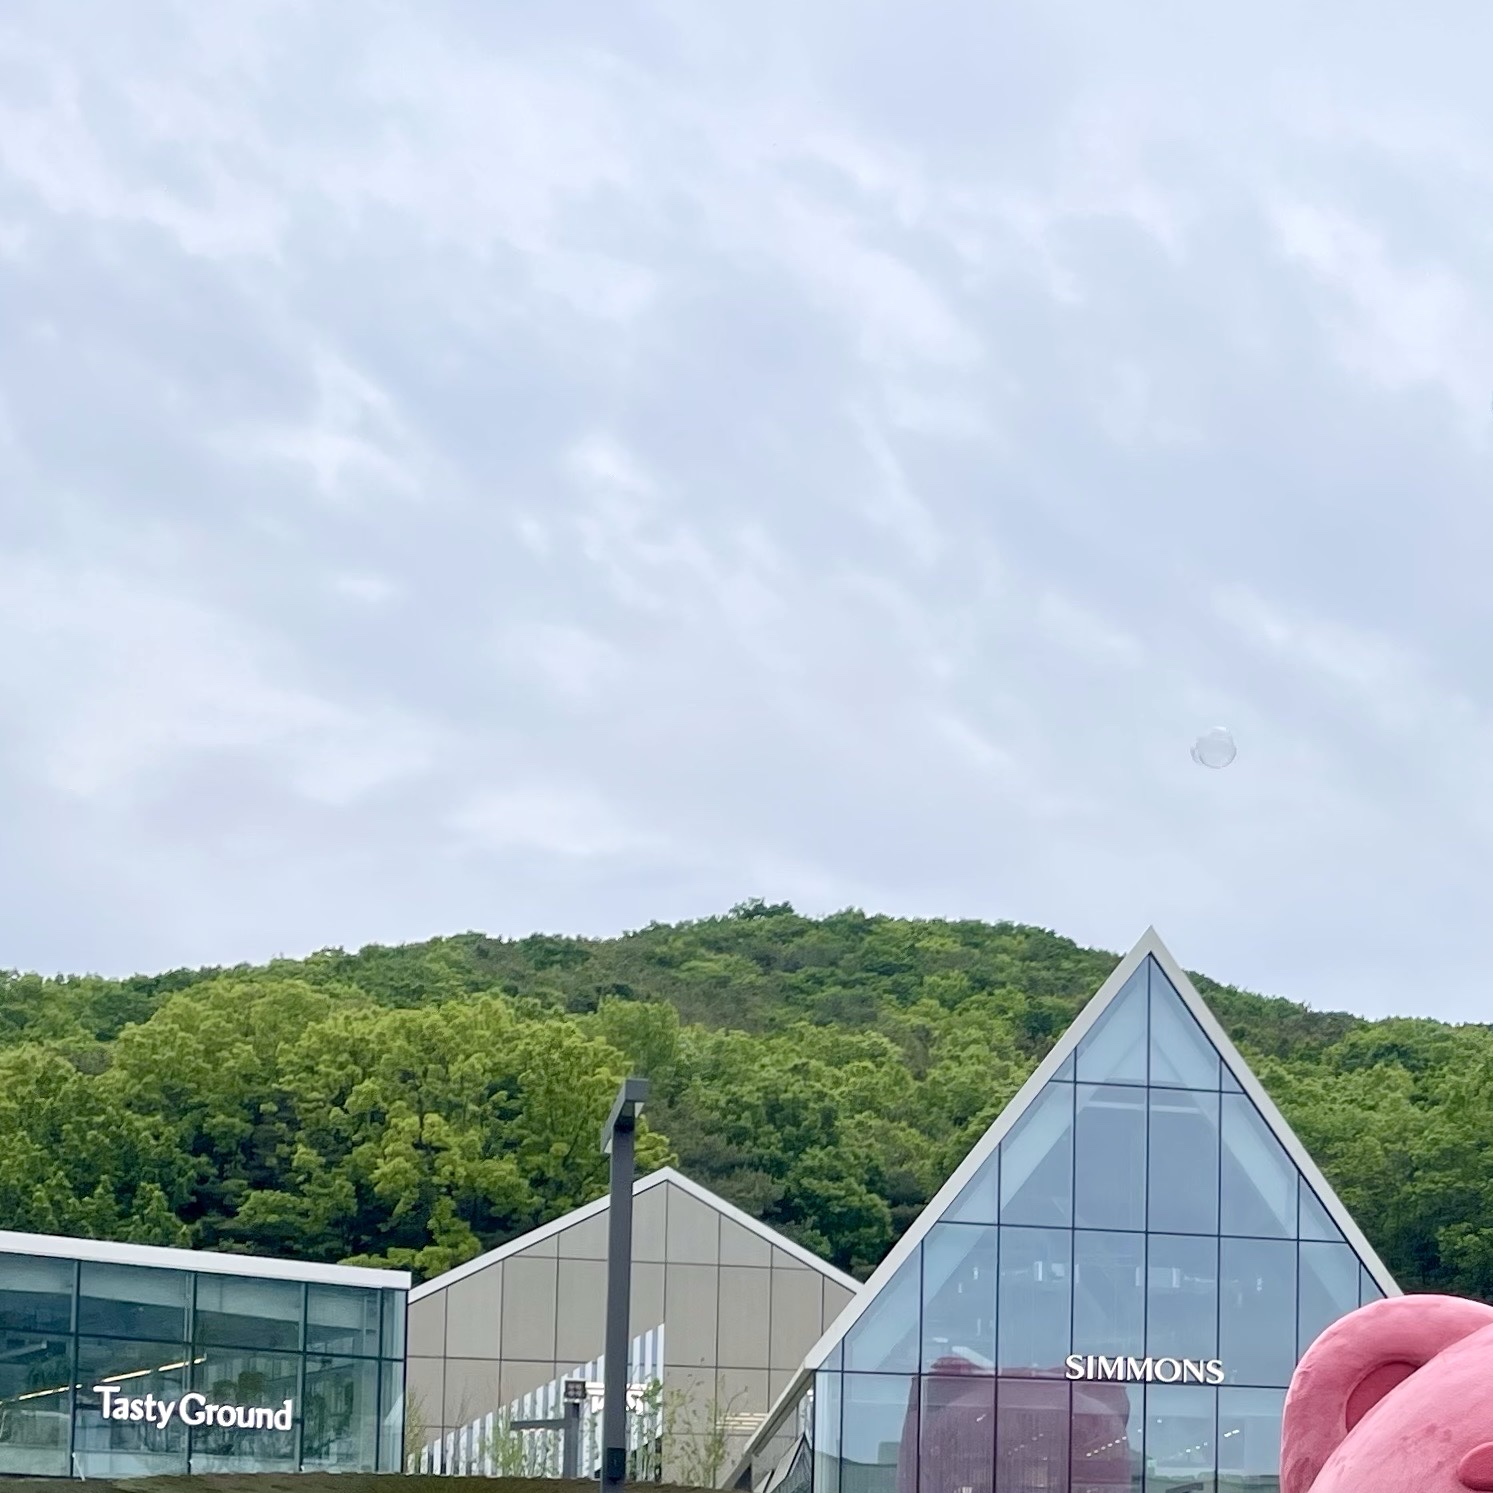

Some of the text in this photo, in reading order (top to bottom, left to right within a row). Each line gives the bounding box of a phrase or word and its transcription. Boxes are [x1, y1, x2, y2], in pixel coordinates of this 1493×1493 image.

[1065, 1354, 1225, 1384] SIMMONS
[93, 1385, 293, 1431] Tasty Ground
